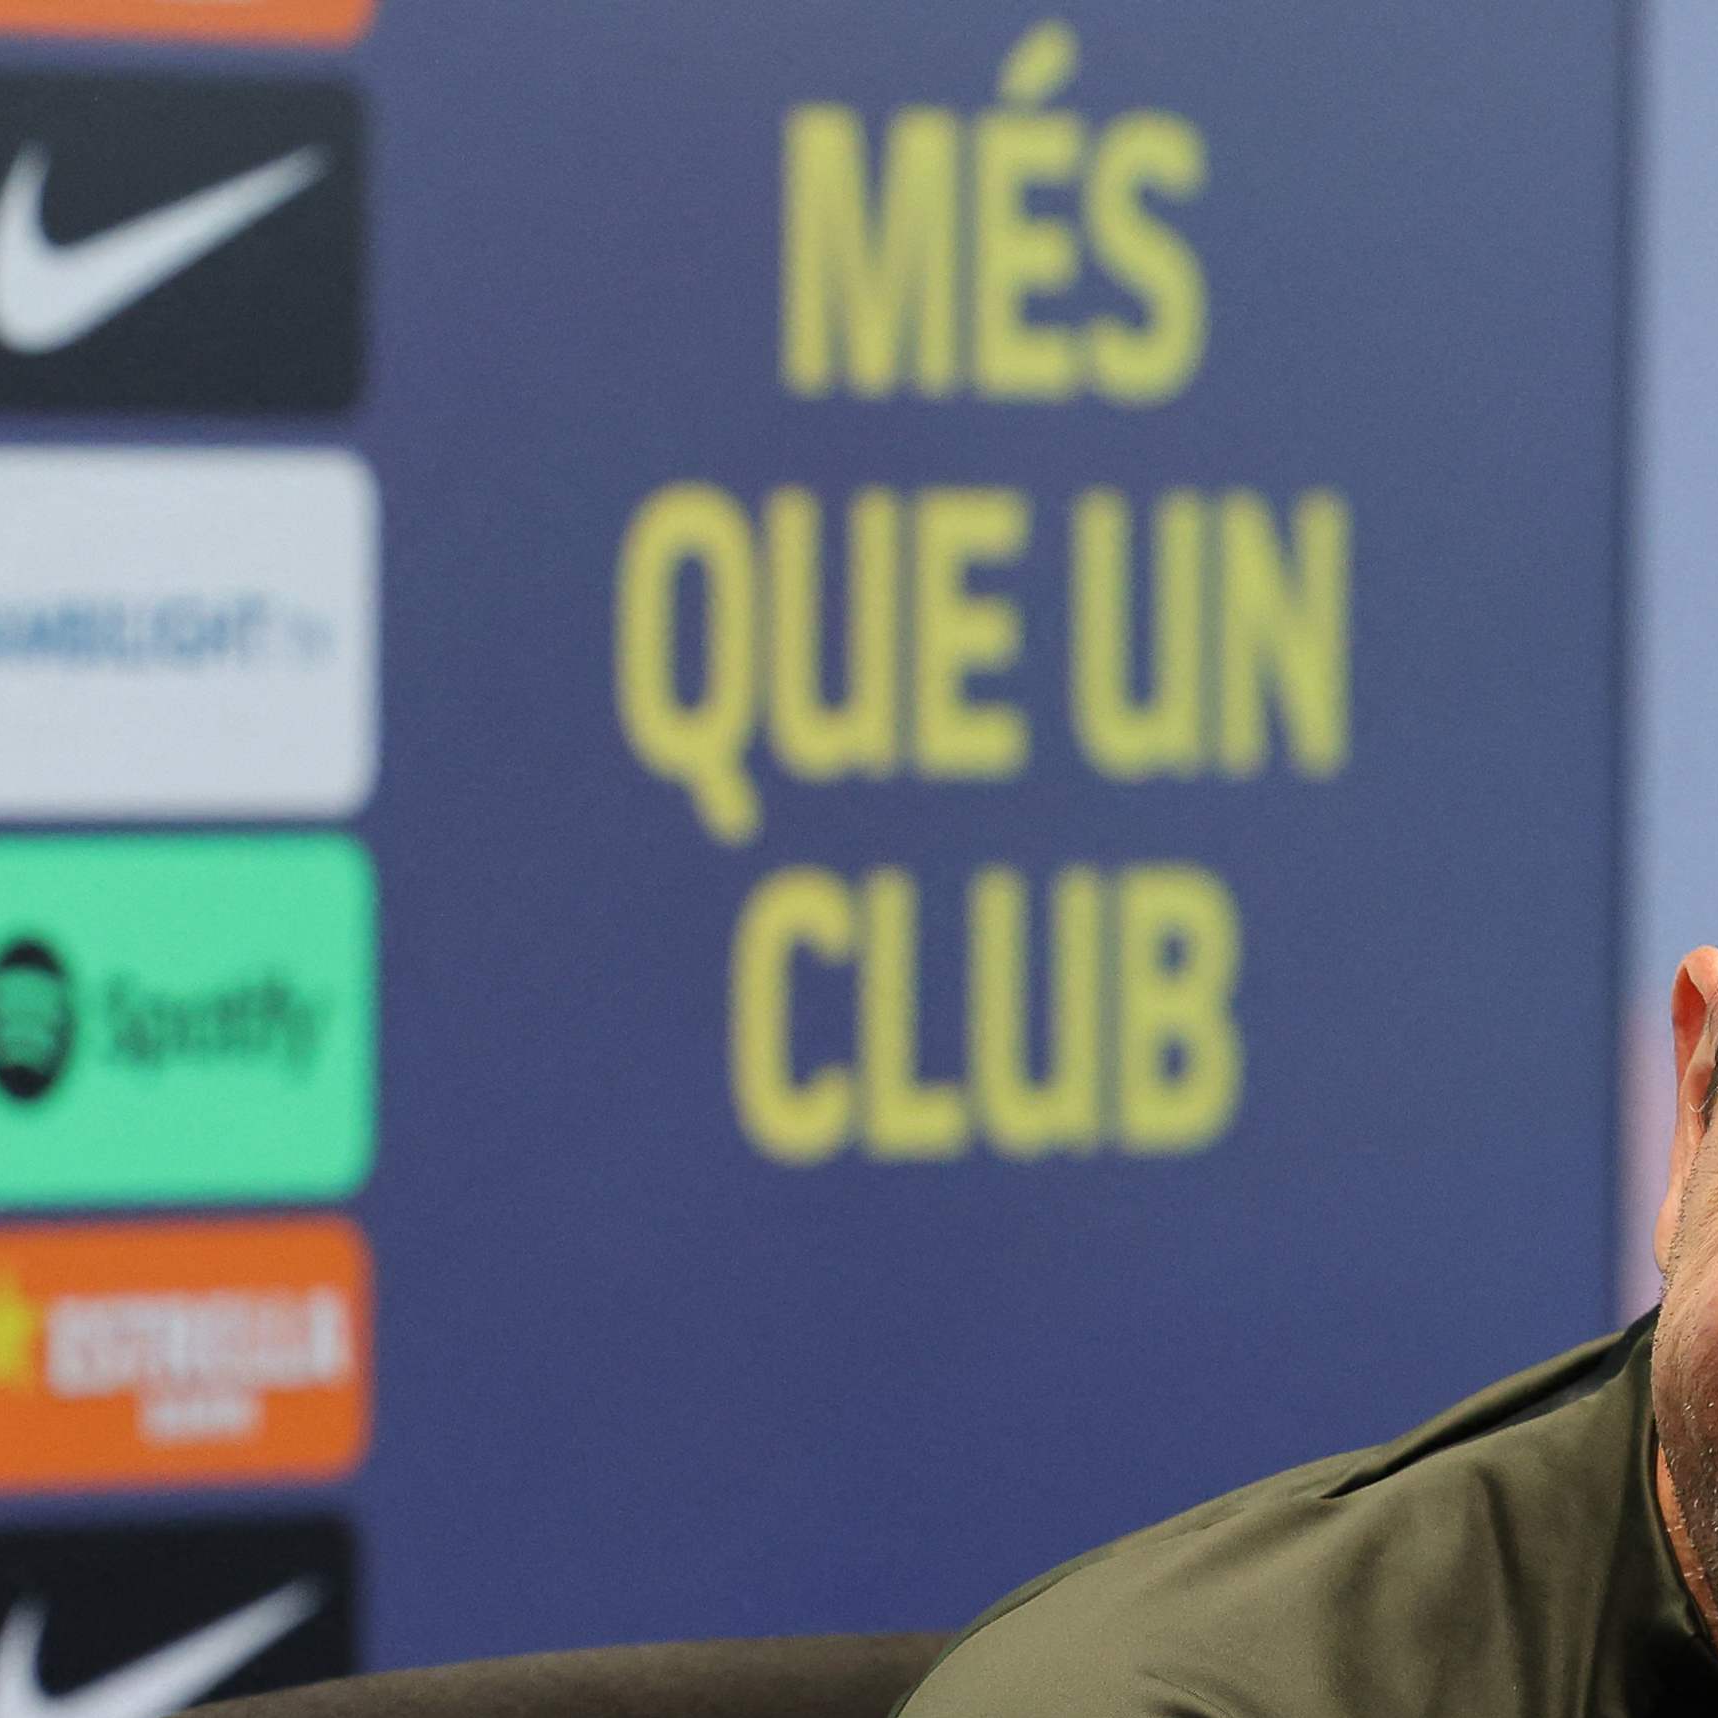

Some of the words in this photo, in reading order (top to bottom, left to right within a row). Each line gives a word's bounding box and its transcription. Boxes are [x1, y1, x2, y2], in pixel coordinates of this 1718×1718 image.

[779, 16, 1209, 404] MÉS
[613, 480, 1033, 848] QUE
[1069, 484, 1351, 782] UN
[95, 966, 335, 1084] Spotify
[727, 860, 1243, 1168] CLUB
